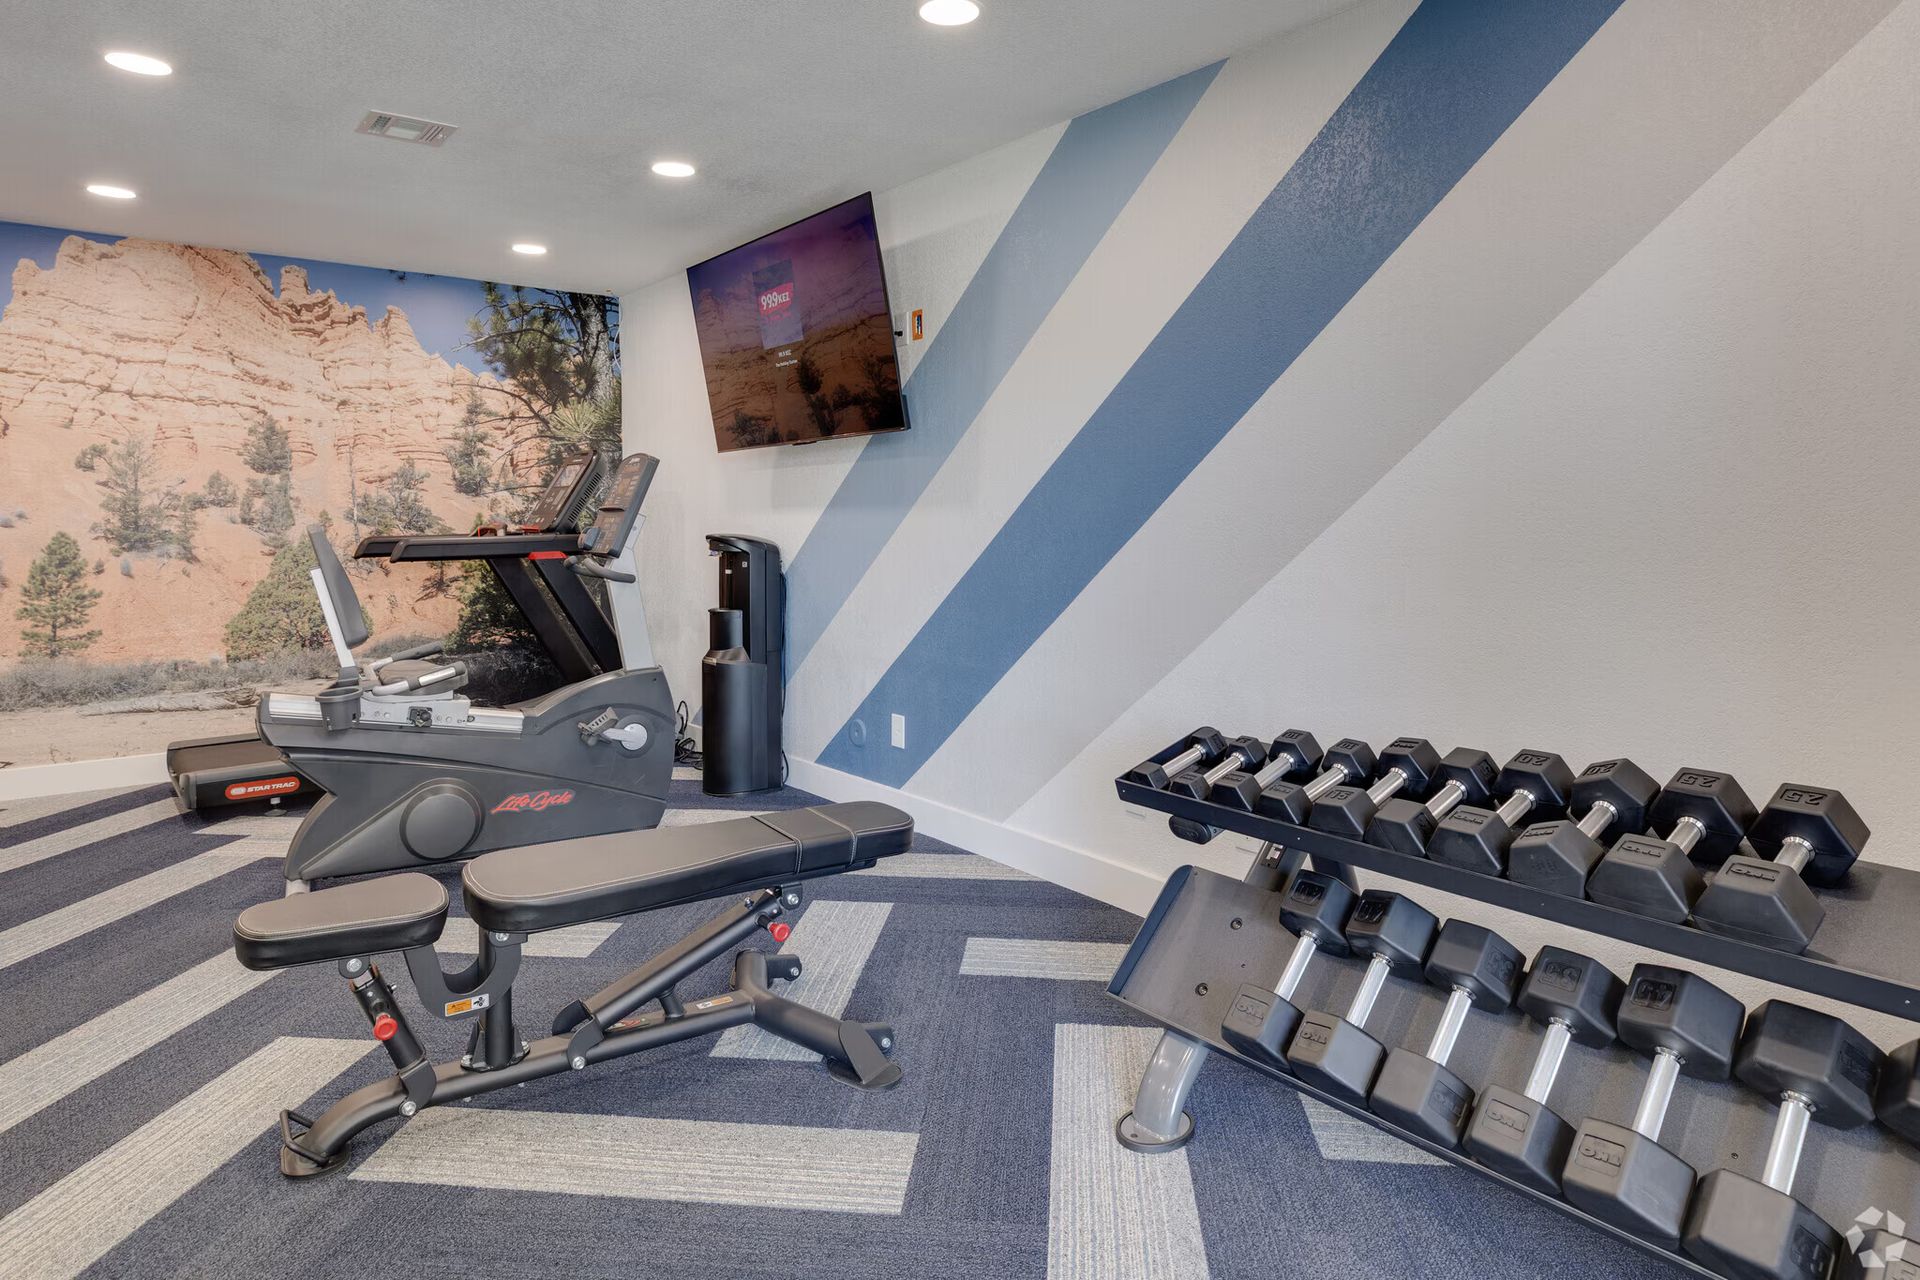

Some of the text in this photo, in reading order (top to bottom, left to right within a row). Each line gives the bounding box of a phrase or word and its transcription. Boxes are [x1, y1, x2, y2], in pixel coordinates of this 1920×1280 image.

[247, 781, 296, 793] STAR TRAC
[1680, 775, 1720, 788] 25
[1783, 791, 1827, 806] 25
